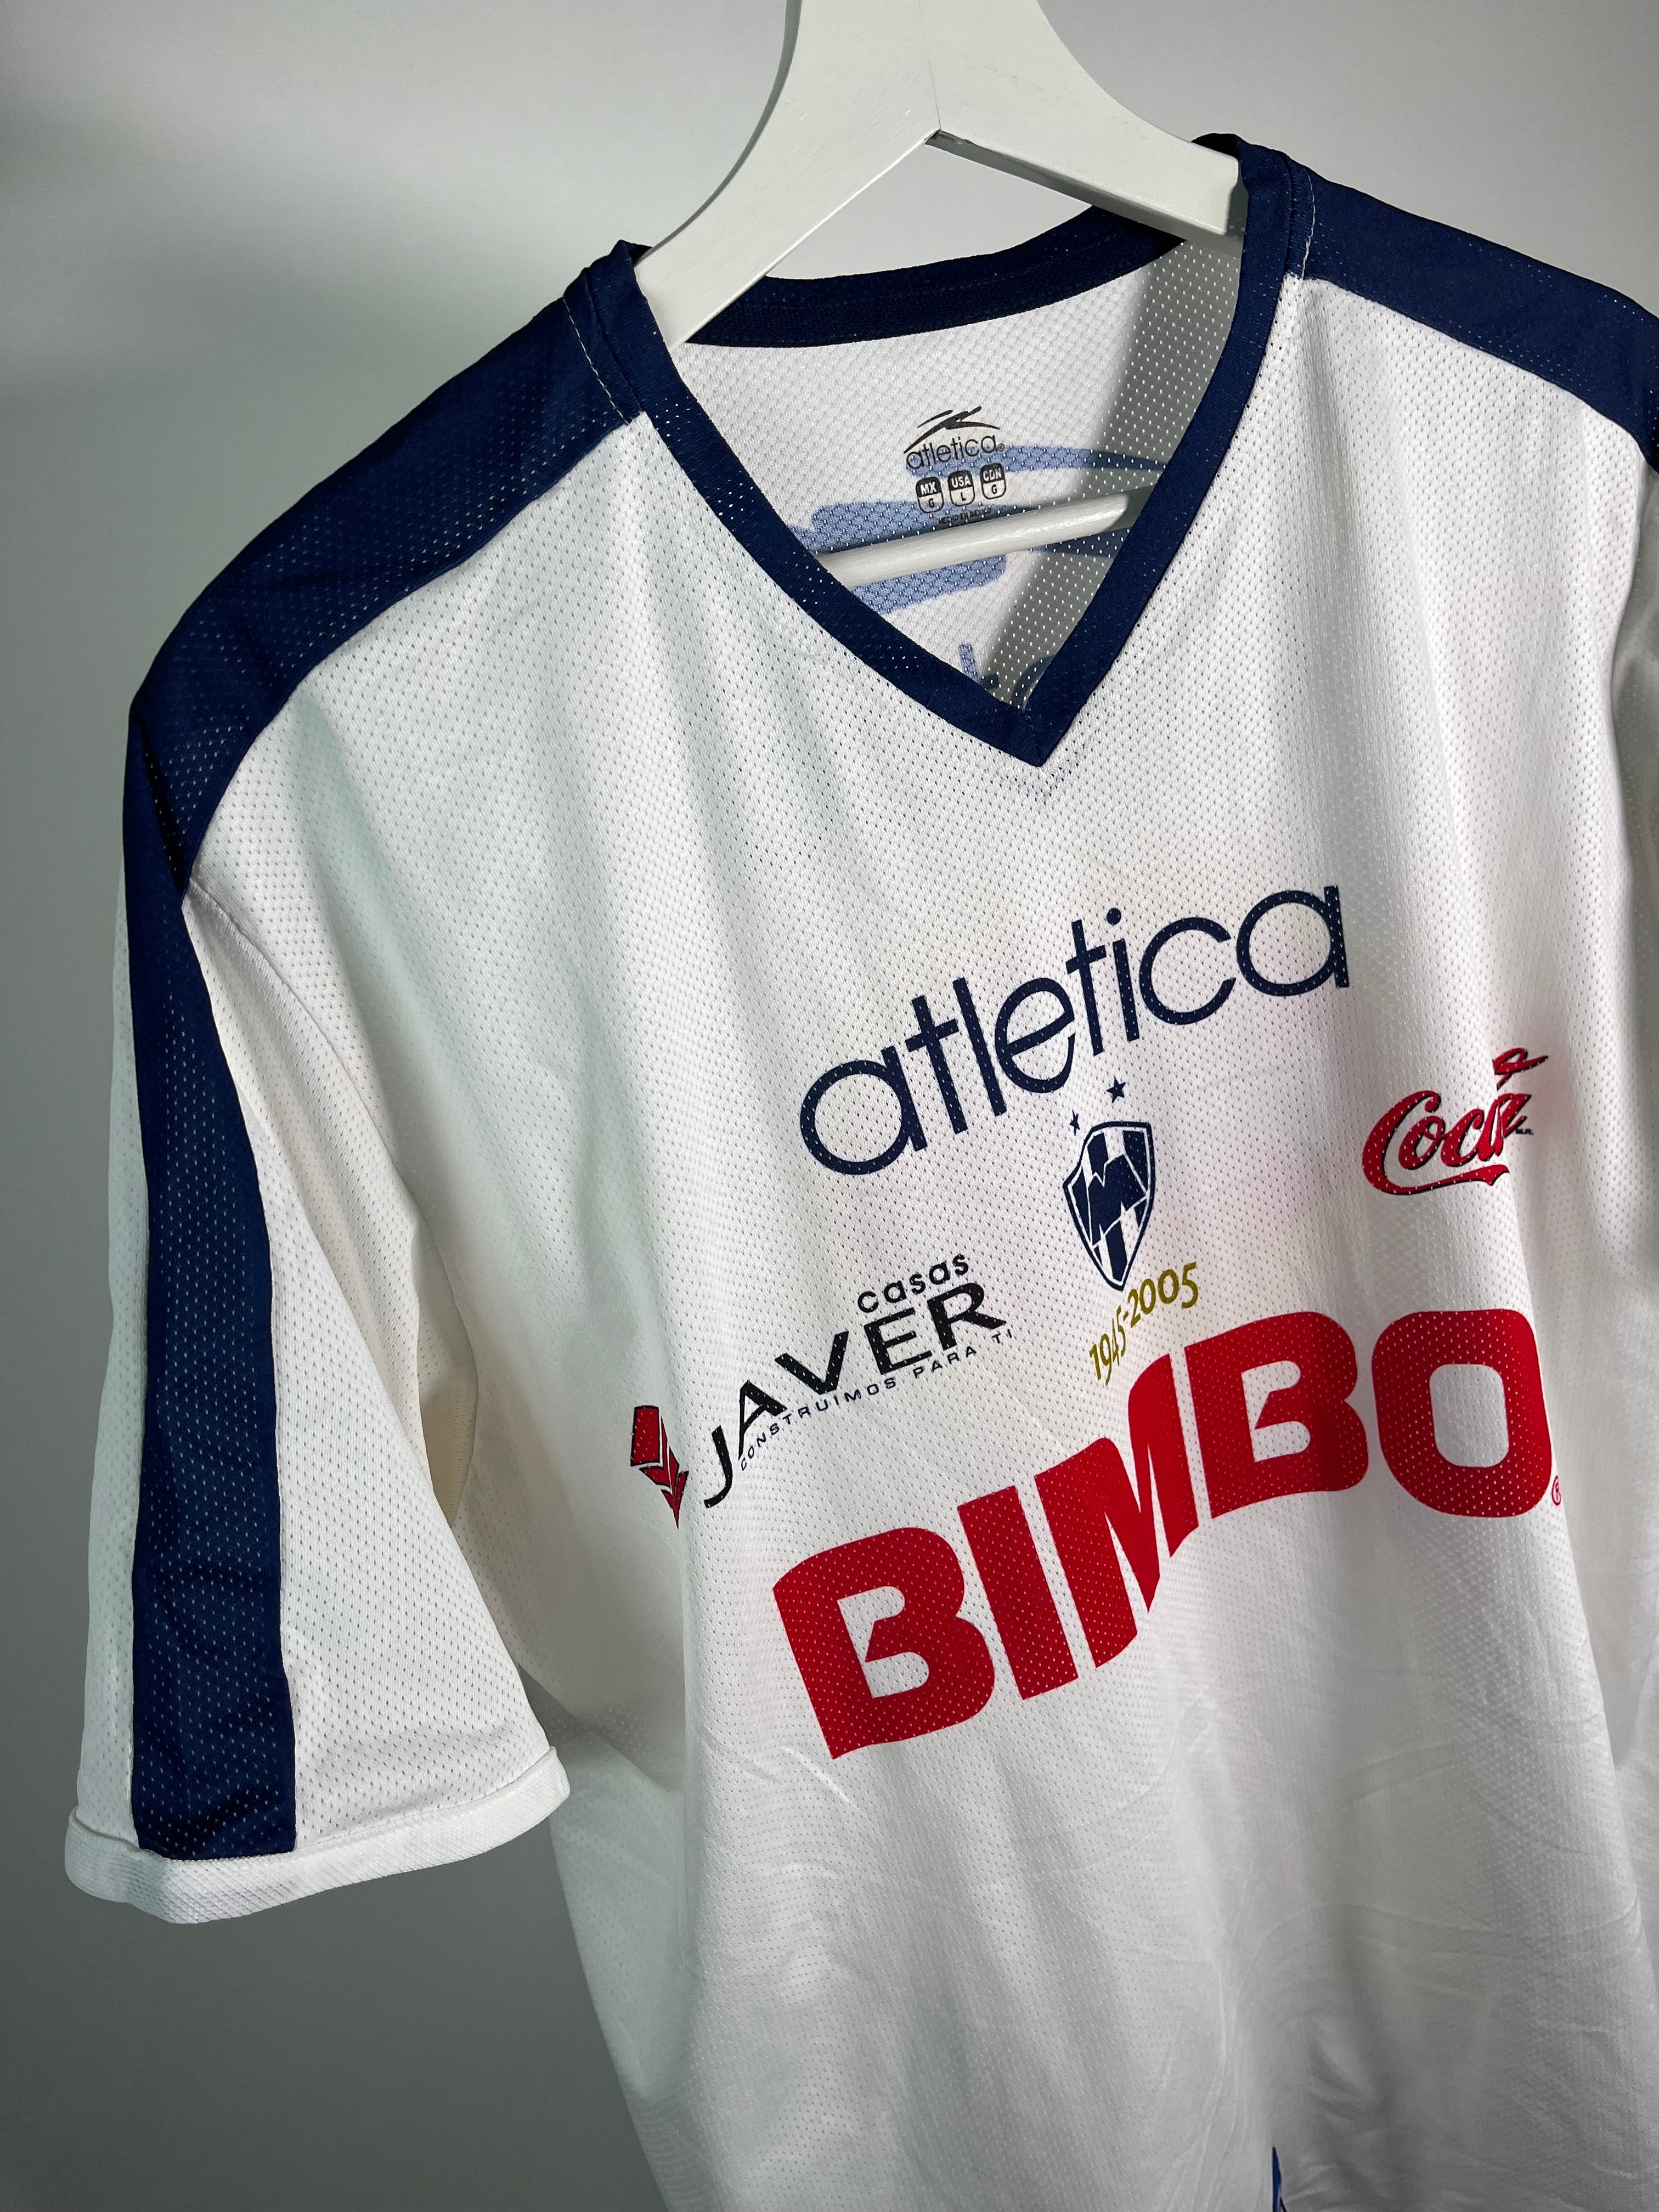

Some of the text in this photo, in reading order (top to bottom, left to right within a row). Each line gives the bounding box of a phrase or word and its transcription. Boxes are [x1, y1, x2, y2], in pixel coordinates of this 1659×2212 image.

[906, 435, 997, 470] atletica
[920, 467, 1002, 494] MX USA CDN
[928, 484, 997, 509] G L G
[960, 511, 969, 520] EN
[799, 884, 1350, 1176] atletica
[857, 1254, 969, 1313] casas
[1089, 1261, 1198, 1386] 1945-2005
[704, 1282, 1007, 1509] JAVER
[740, 1328, 1013, 1471] CONSTRUIMOS PARA TI
[772, 1308, 1552, 1759] BIMBO
